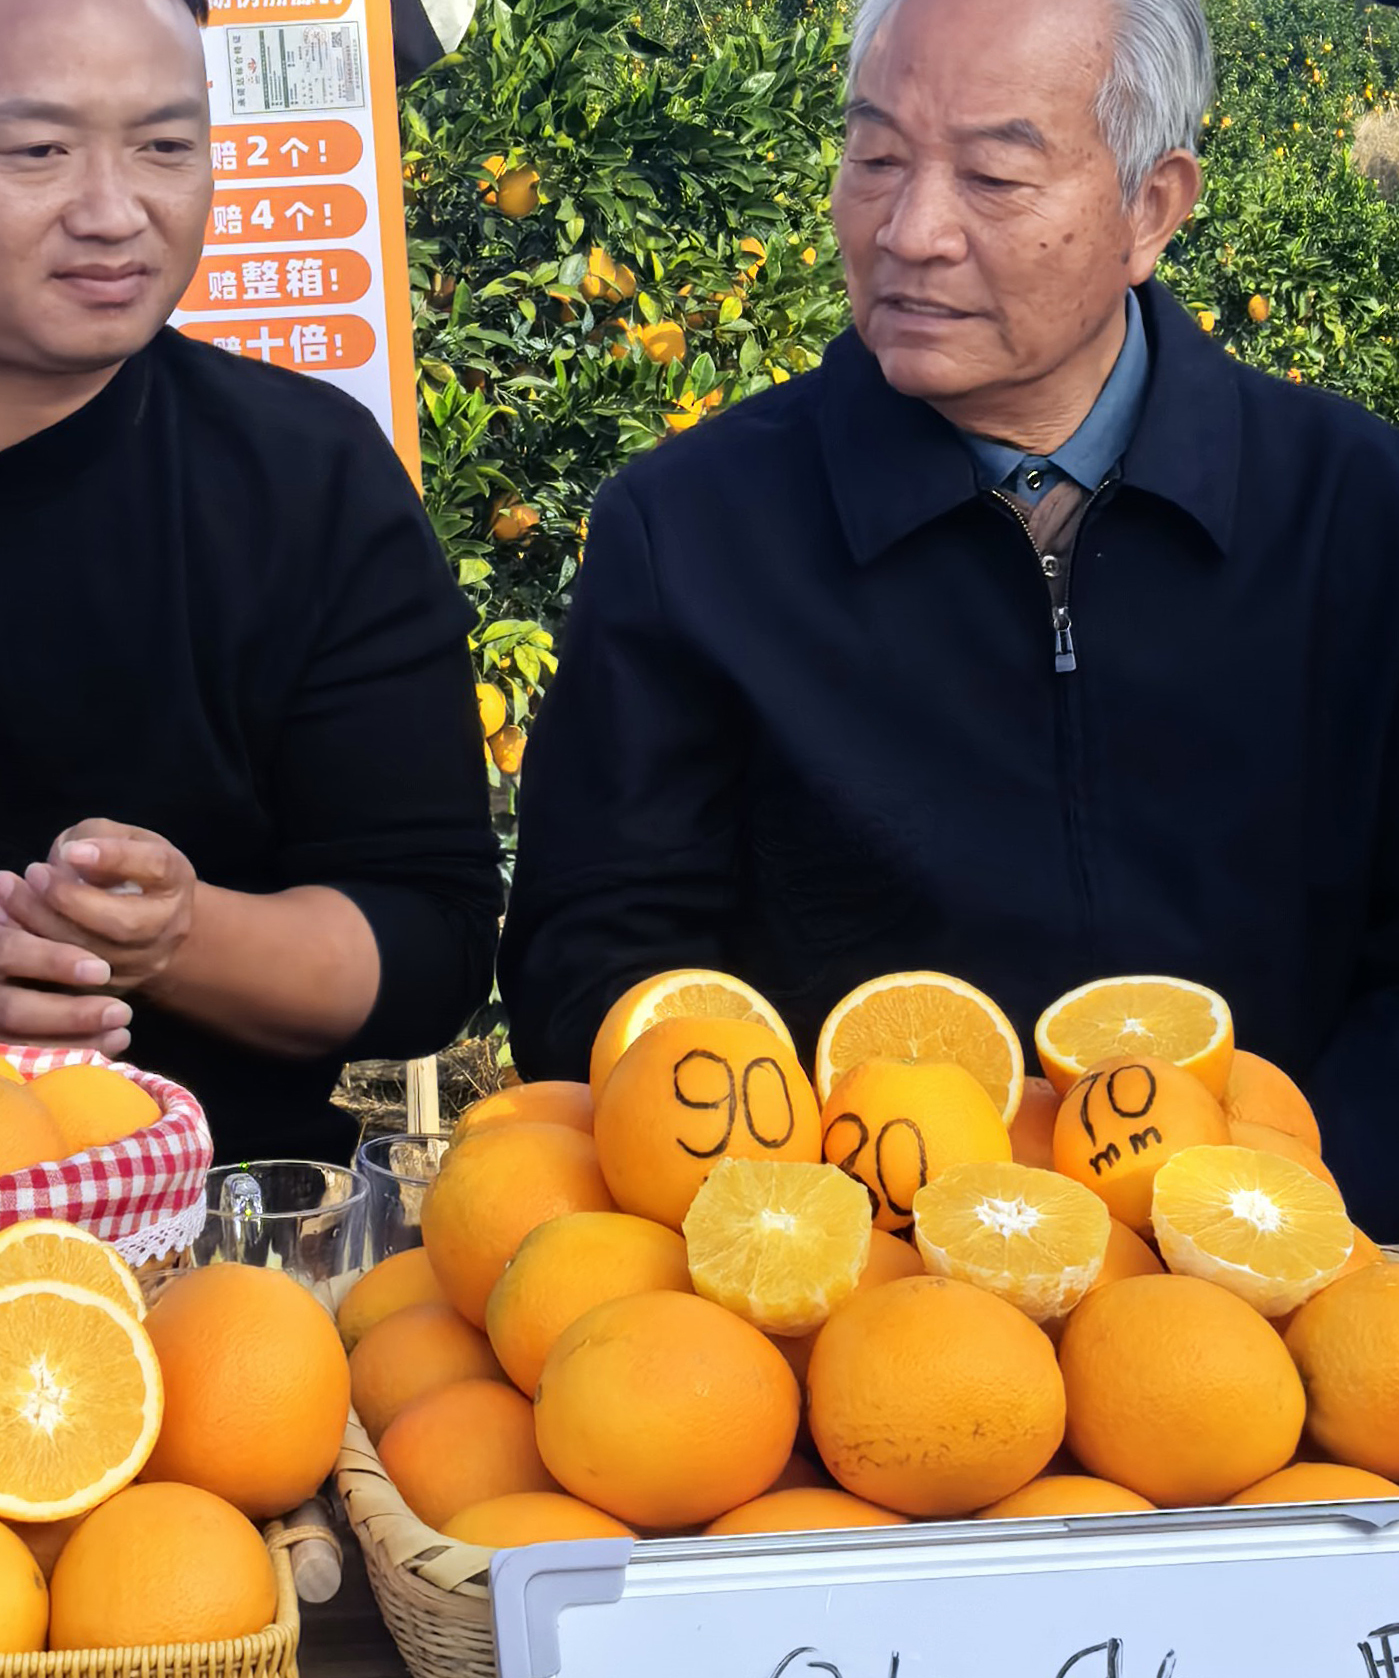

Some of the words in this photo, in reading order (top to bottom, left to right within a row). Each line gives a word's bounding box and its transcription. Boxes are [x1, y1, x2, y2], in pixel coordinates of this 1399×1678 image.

[210, 135, 328, 171] 赔2个！
[213, 199, 333, 235] 赔4个！
[208, 258, 340, 301] 赔整箱！
[673, 1048, 795, 1159] 90
[1063, 1065, 1157, 1147] 70
[1089, 1126, 1162, 1176] mm
